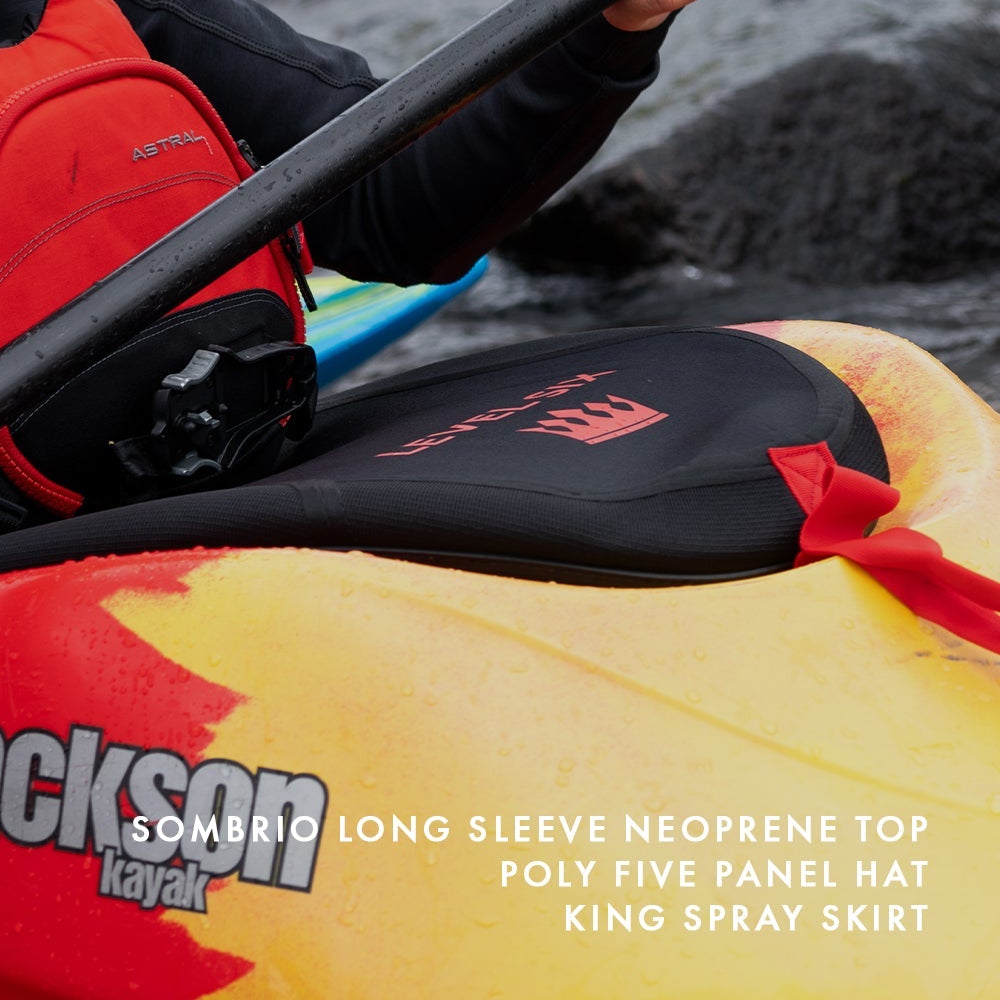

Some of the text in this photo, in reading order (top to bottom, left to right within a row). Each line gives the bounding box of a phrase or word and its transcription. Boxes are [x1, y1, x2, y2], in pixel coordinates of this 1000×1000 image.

[132, 129, 203, 163] ASTRAL
[374, 400, 541, 458] LEVEL
[97, 847, 208, 914] kayak
